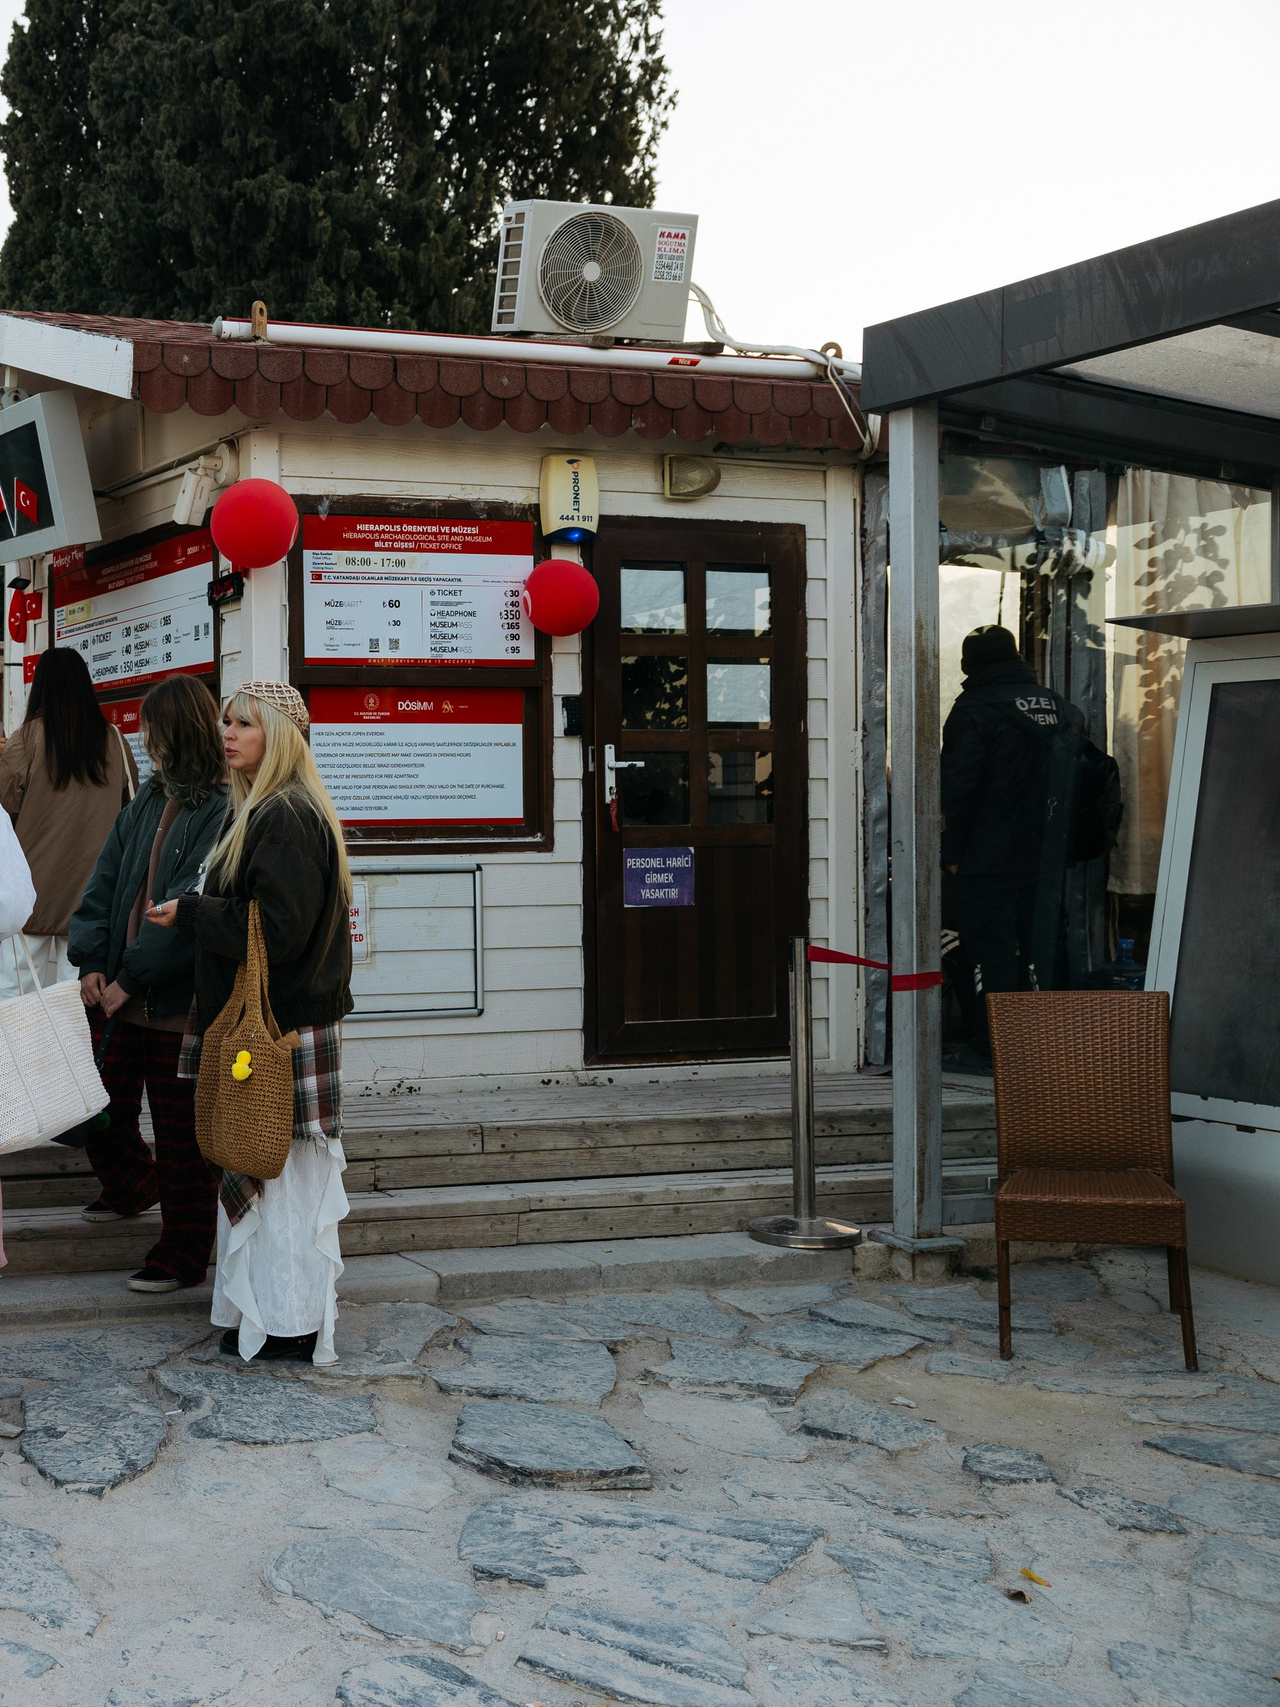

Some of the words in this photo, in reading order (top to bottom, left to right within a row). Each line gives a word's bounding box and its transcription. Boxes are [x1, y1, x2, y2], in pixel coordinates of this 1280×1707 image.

[571, 471, 580, 513] PRONET
[357, 524, 401, 532] HIERAPOLIS
[402, 523, 439, 533] ÖRENYERİ
[451, 525, 479, 534] MÜZESİ
[380, 533, 436, 541] ARCHAEOLOGICAL
[393, 541, 415, 549] GİŞESİ
[345, 557, 371, 567] 08:00
[381, 558, 406, 568] 17:00
[504, 600, 520, 608] €40
[436, 610, 477, 618] HEADPHONE
[501, 622, 520, 630] €165
[95, 631, 112, 644] TICKET
[504, 633, 520, 641] €90
[504, 646, 521, 654] €95
[95, 664, 119, 677] HEADPHONE
[397, 700, 434, 711] DÖSİMM
[626, 858, 665, 868] PERSONEL
[666, 855, 691, 868] HARİCİ
[645, 872, 674, 884] GİRMEK
[640, 888, 678, 899] YASAKTIR!
